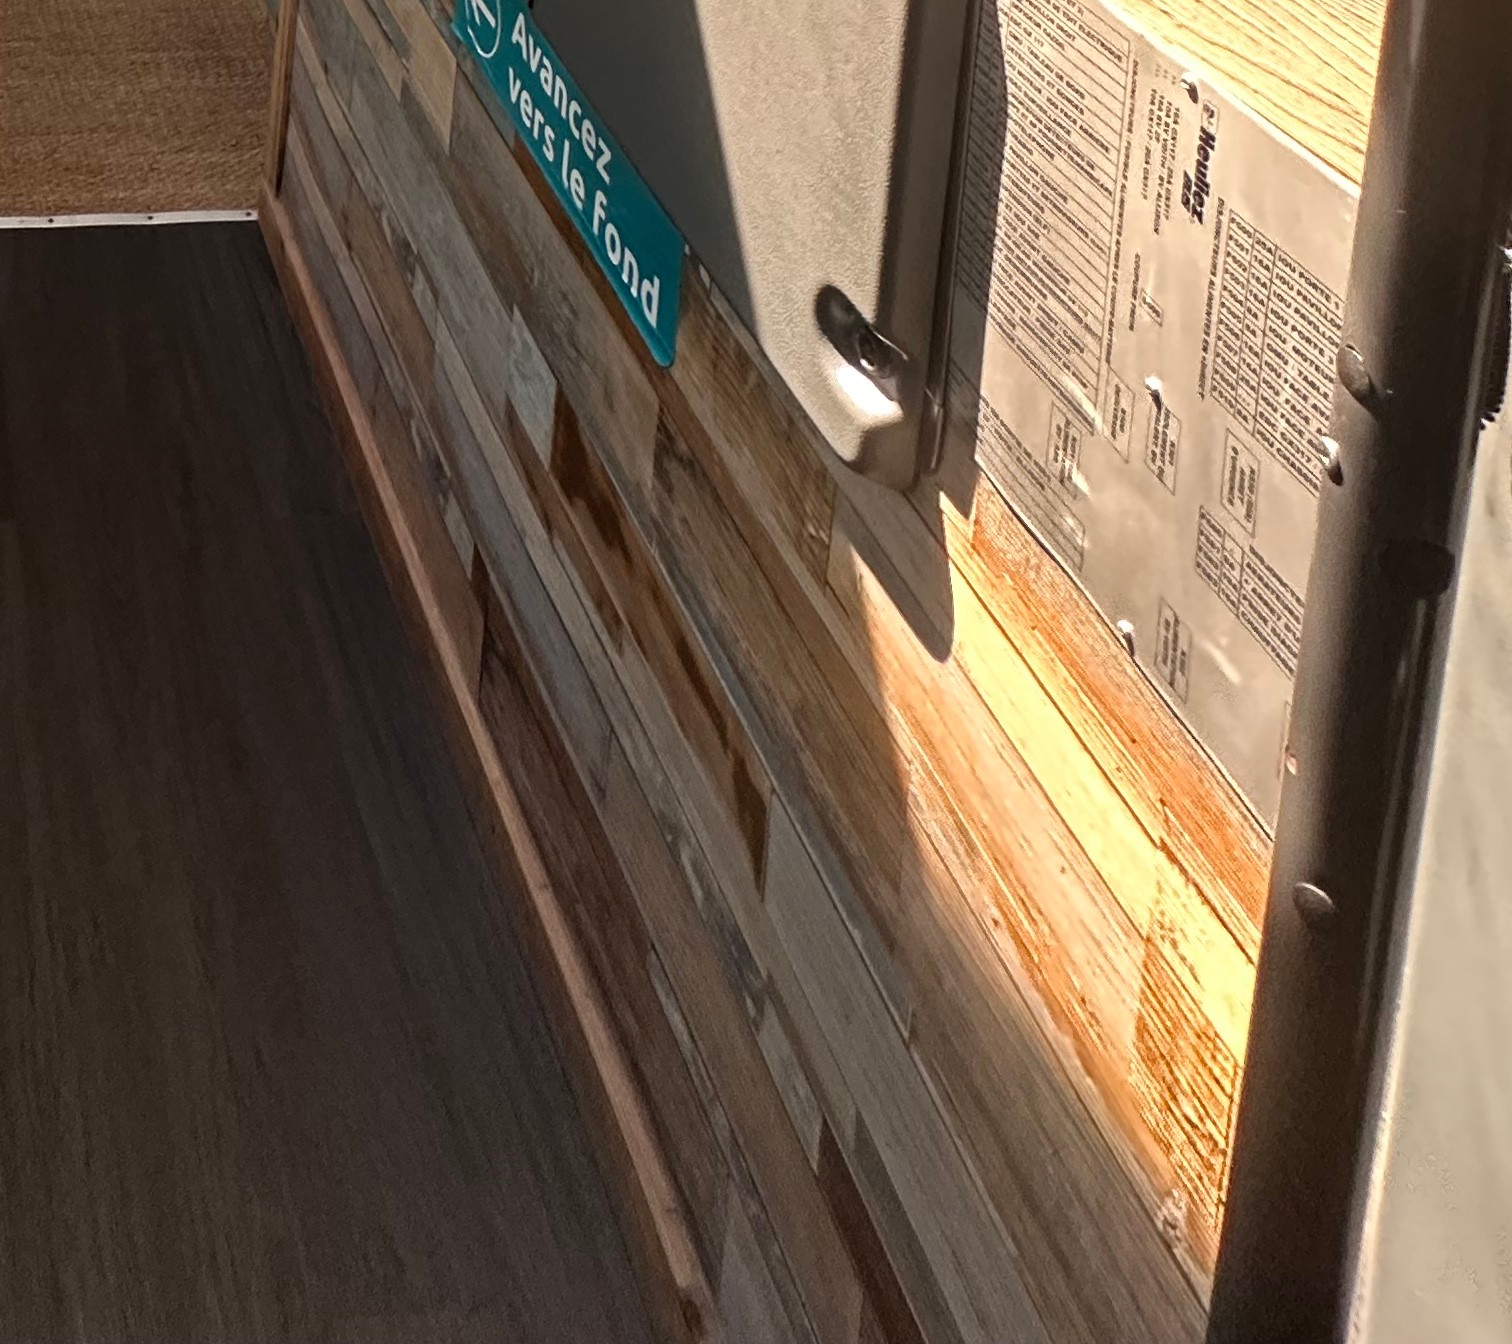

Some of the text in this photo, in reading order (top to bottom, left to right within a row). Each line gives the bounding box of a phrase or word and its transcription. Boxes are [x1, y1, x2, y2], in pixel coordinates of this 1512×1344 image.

[511, 12, 612, 185] Avancez
[1190, 123, 1216, 230] Heuliez
[507, 66, 660, 329] vers le fond
